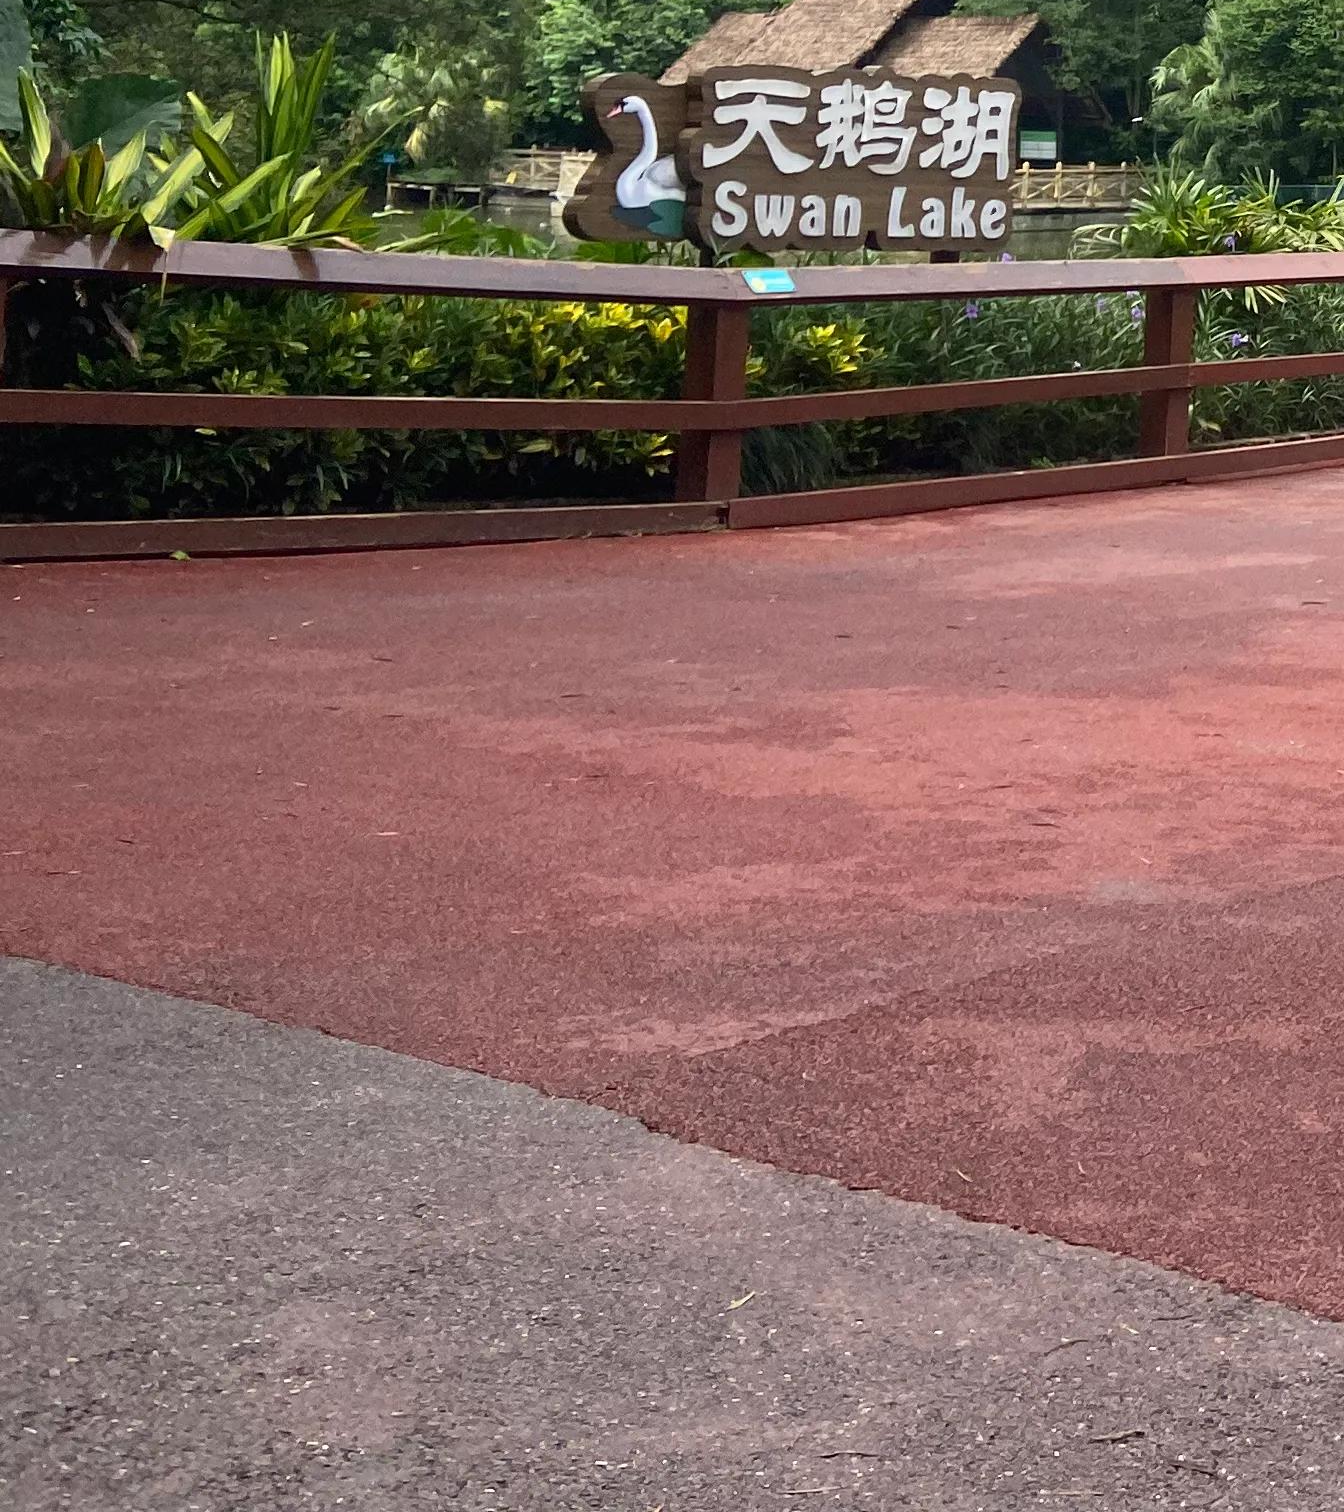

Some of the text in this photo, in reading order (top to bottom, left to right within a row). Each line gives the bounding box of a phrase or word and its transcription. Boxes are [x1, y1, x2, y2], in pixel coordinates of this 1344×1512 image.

[702, 78, 1016, 181] 天鹅湖
[711, 179, 1007, 240] Swan Lake
